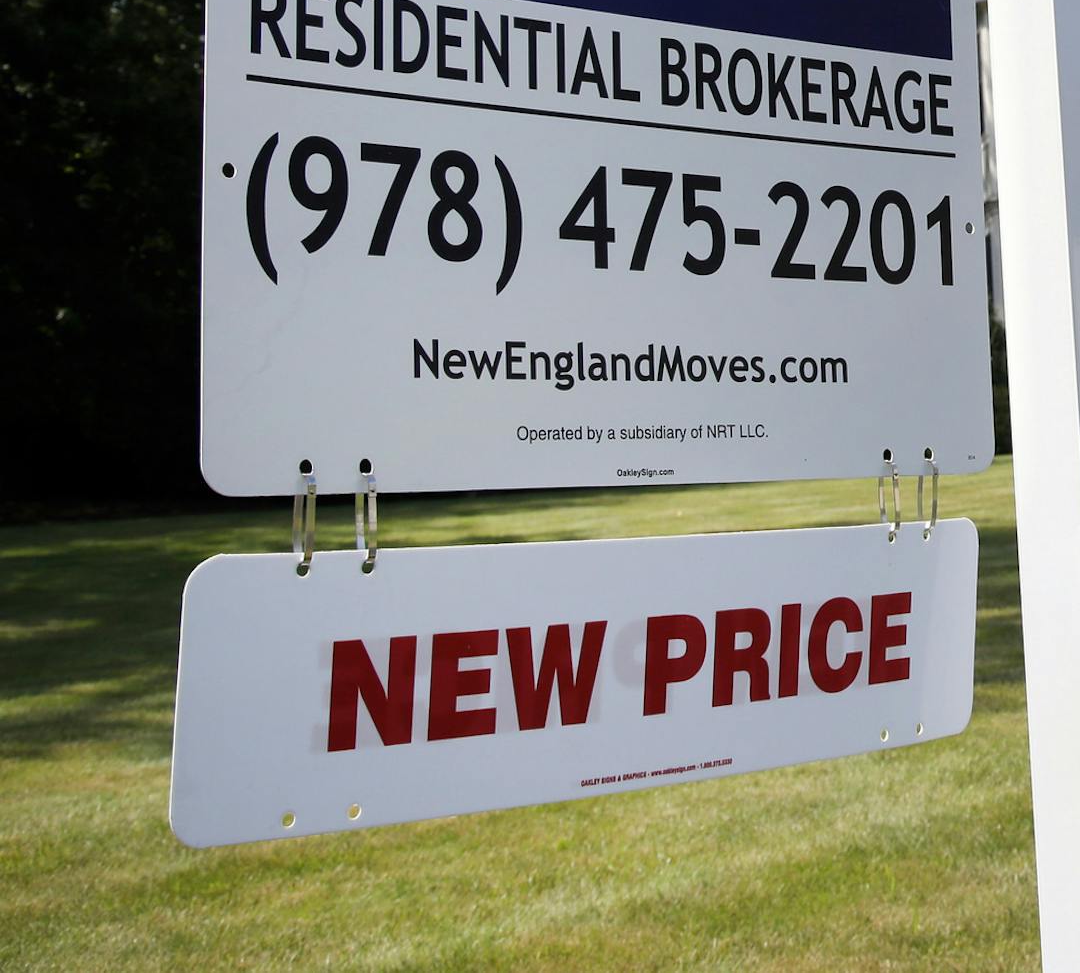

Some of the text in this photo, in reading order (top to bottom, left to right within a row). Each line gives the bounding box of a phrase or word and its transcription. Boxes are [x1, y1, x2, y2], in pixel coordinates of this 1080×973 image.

[660, 37, 954, 137] BROKERAGE
[246, 132, 954, 295] (978) 475-2201
[413, 338, 849, 391] NewEnglandMoves.com
[516, 424, 769, 444] Operated by a subsidiary of NRT LLC.
[616, 468, 675, 478] OakleySign.com
[327, 591, 912, 753] NEW PRICE
